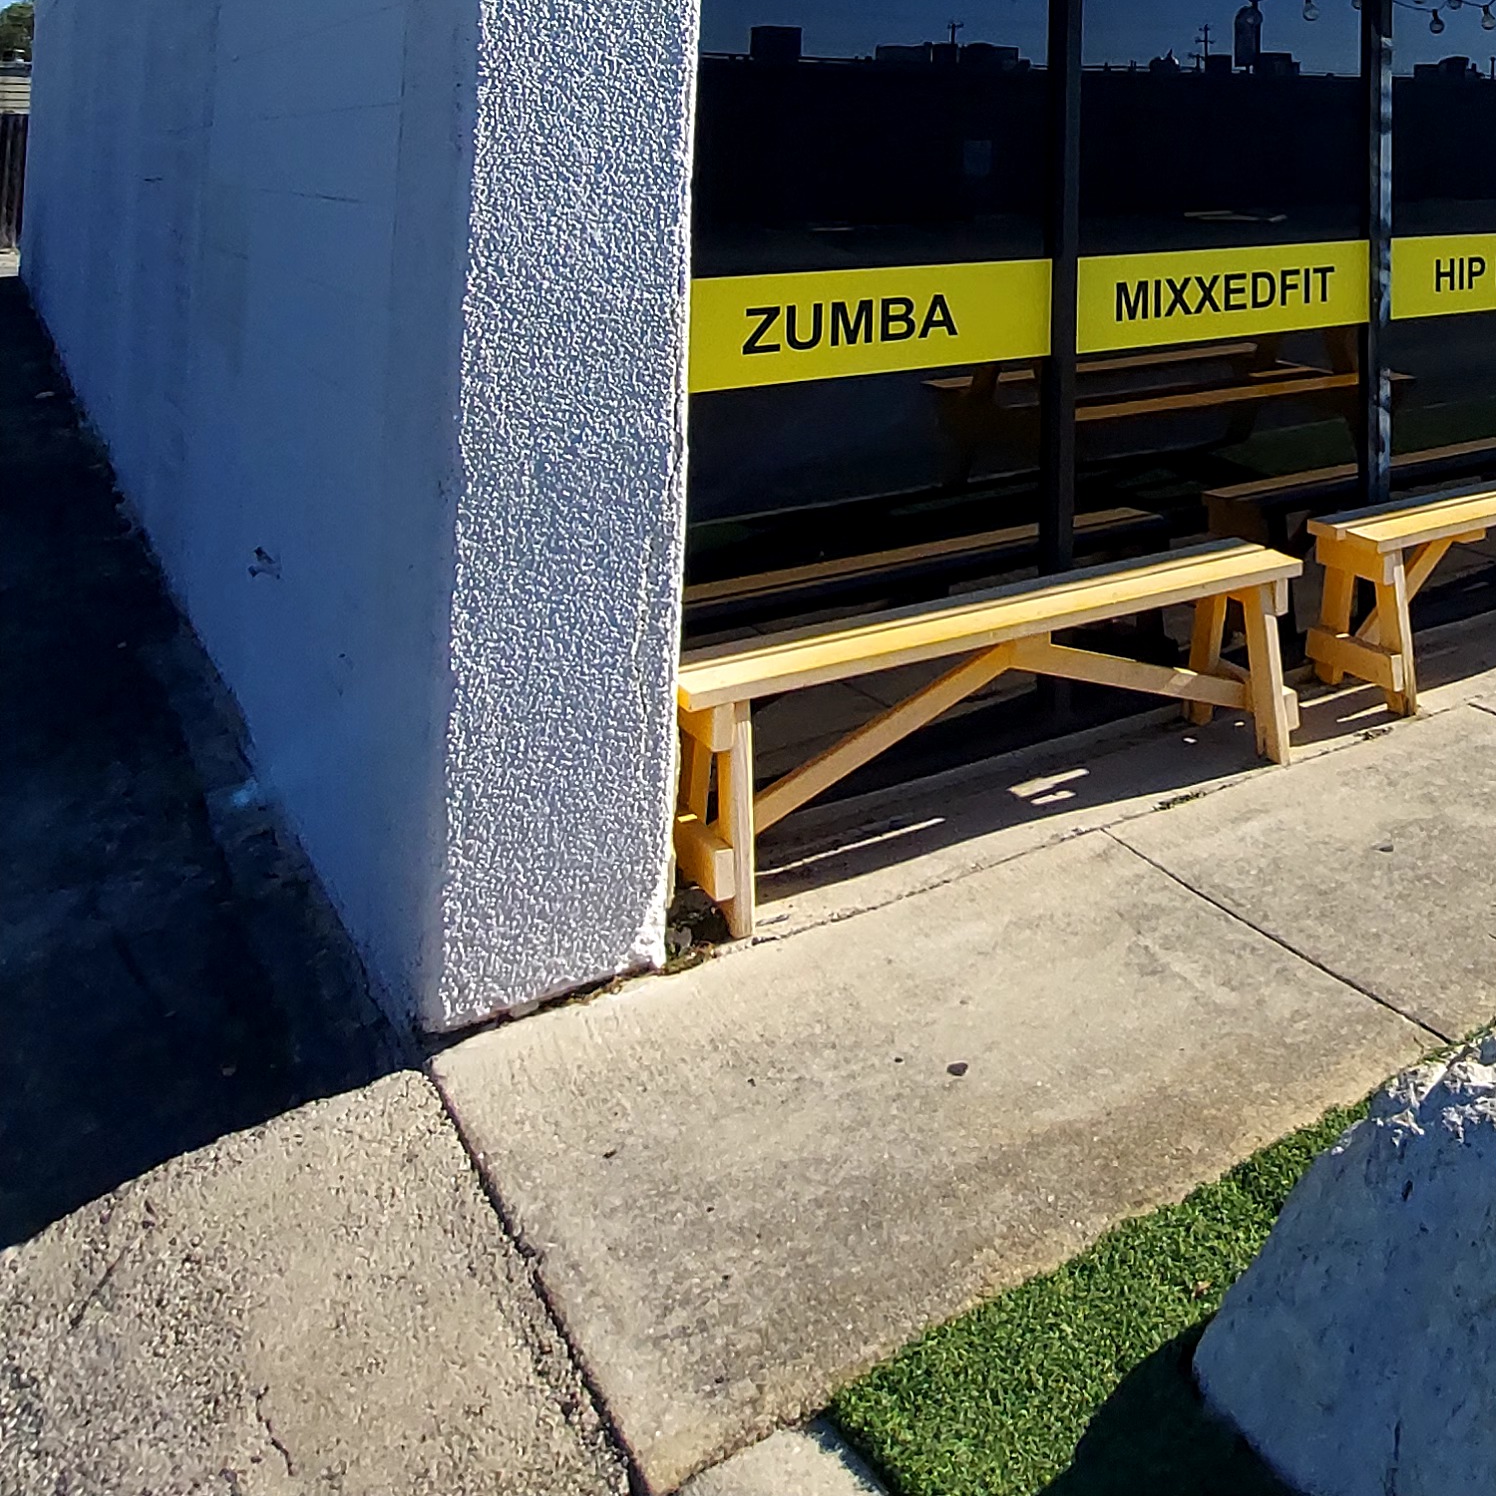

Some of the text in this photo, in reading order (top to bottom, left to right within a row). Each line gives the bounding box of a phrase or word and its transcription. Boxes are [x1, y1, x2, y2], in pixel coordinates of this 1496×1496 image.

[1115, 266, 1335, 322] MIXXEDFIT
[1435, 256, 1486, 292] HIP
[742, 294, 958, 355] ZUMBA
